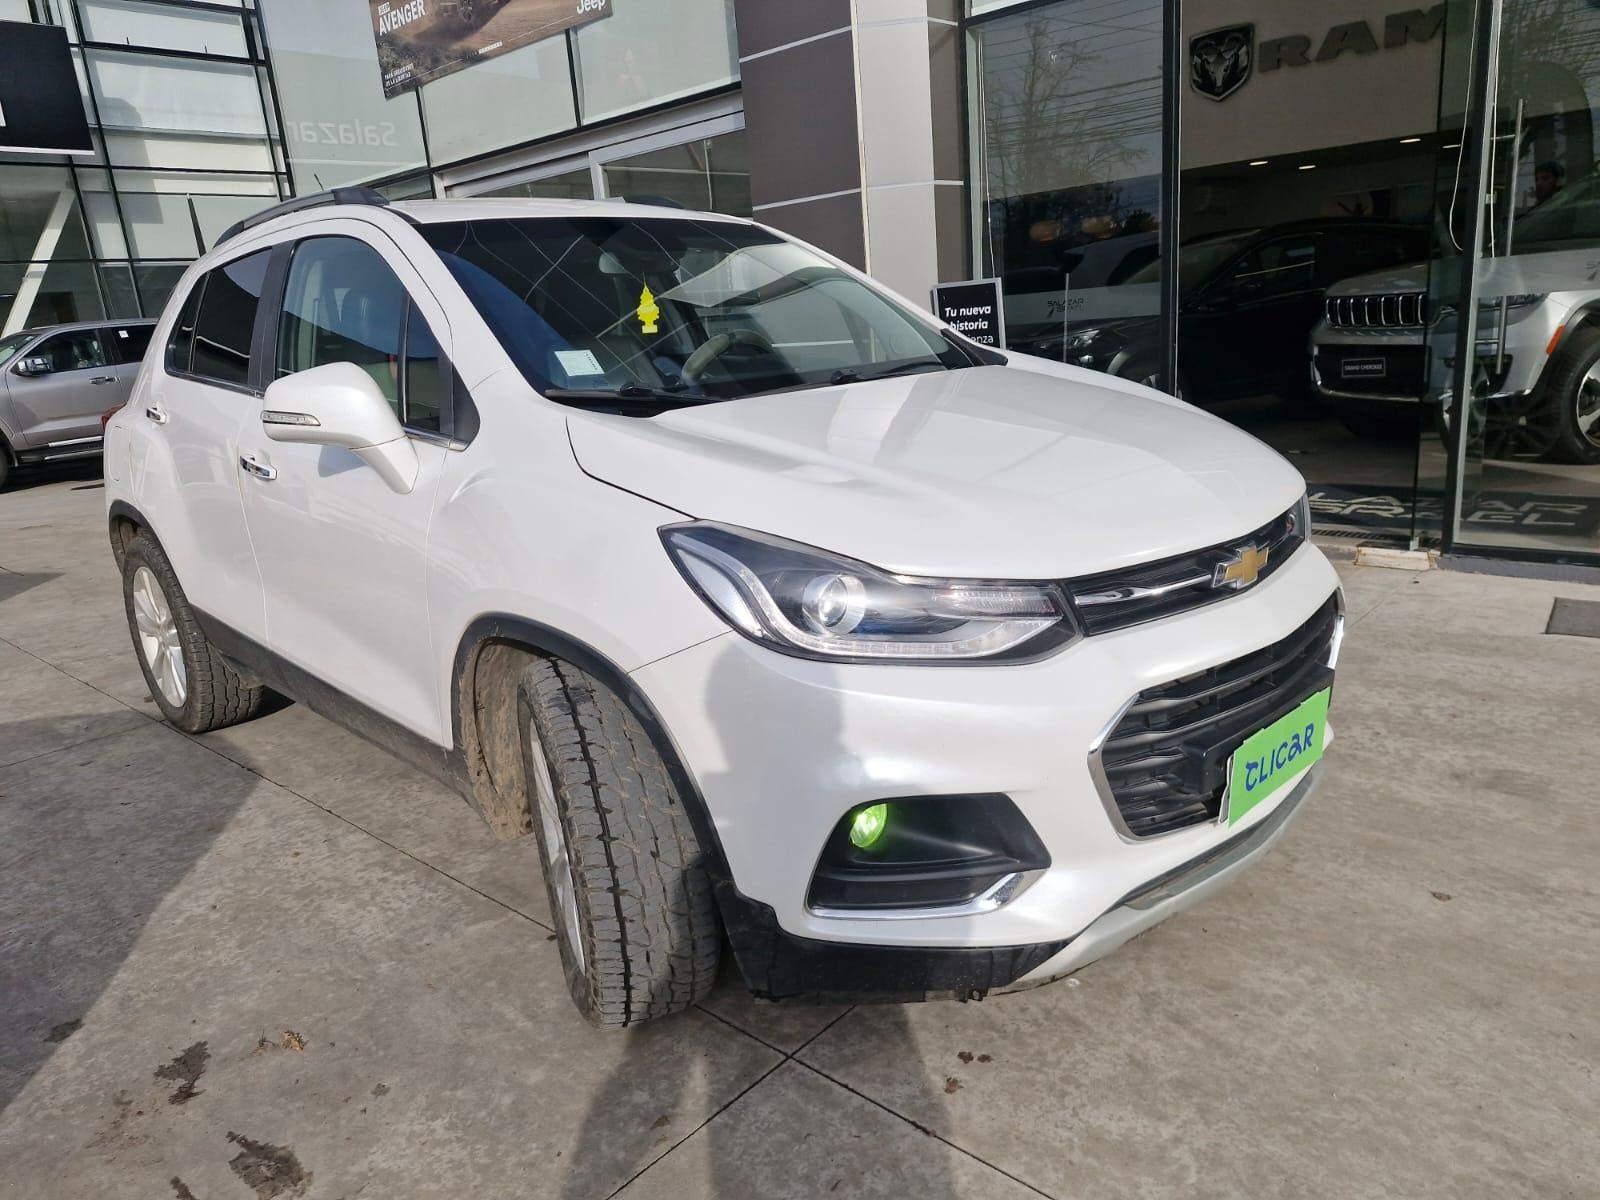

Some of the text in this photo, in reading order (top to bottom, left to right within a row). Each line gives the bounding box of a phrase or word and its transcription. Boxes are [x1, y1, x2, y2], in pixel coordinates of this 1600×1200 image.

[576, 0, 606, 14] Jeep
[379, 0, 426, 36] AVENGER
[1258, 5, 1446, 73] RAM
[944, 305, 992, 317] Tu nueva
[950, 318, 989, 331] historia
[967, 334, 994, 344] enza
